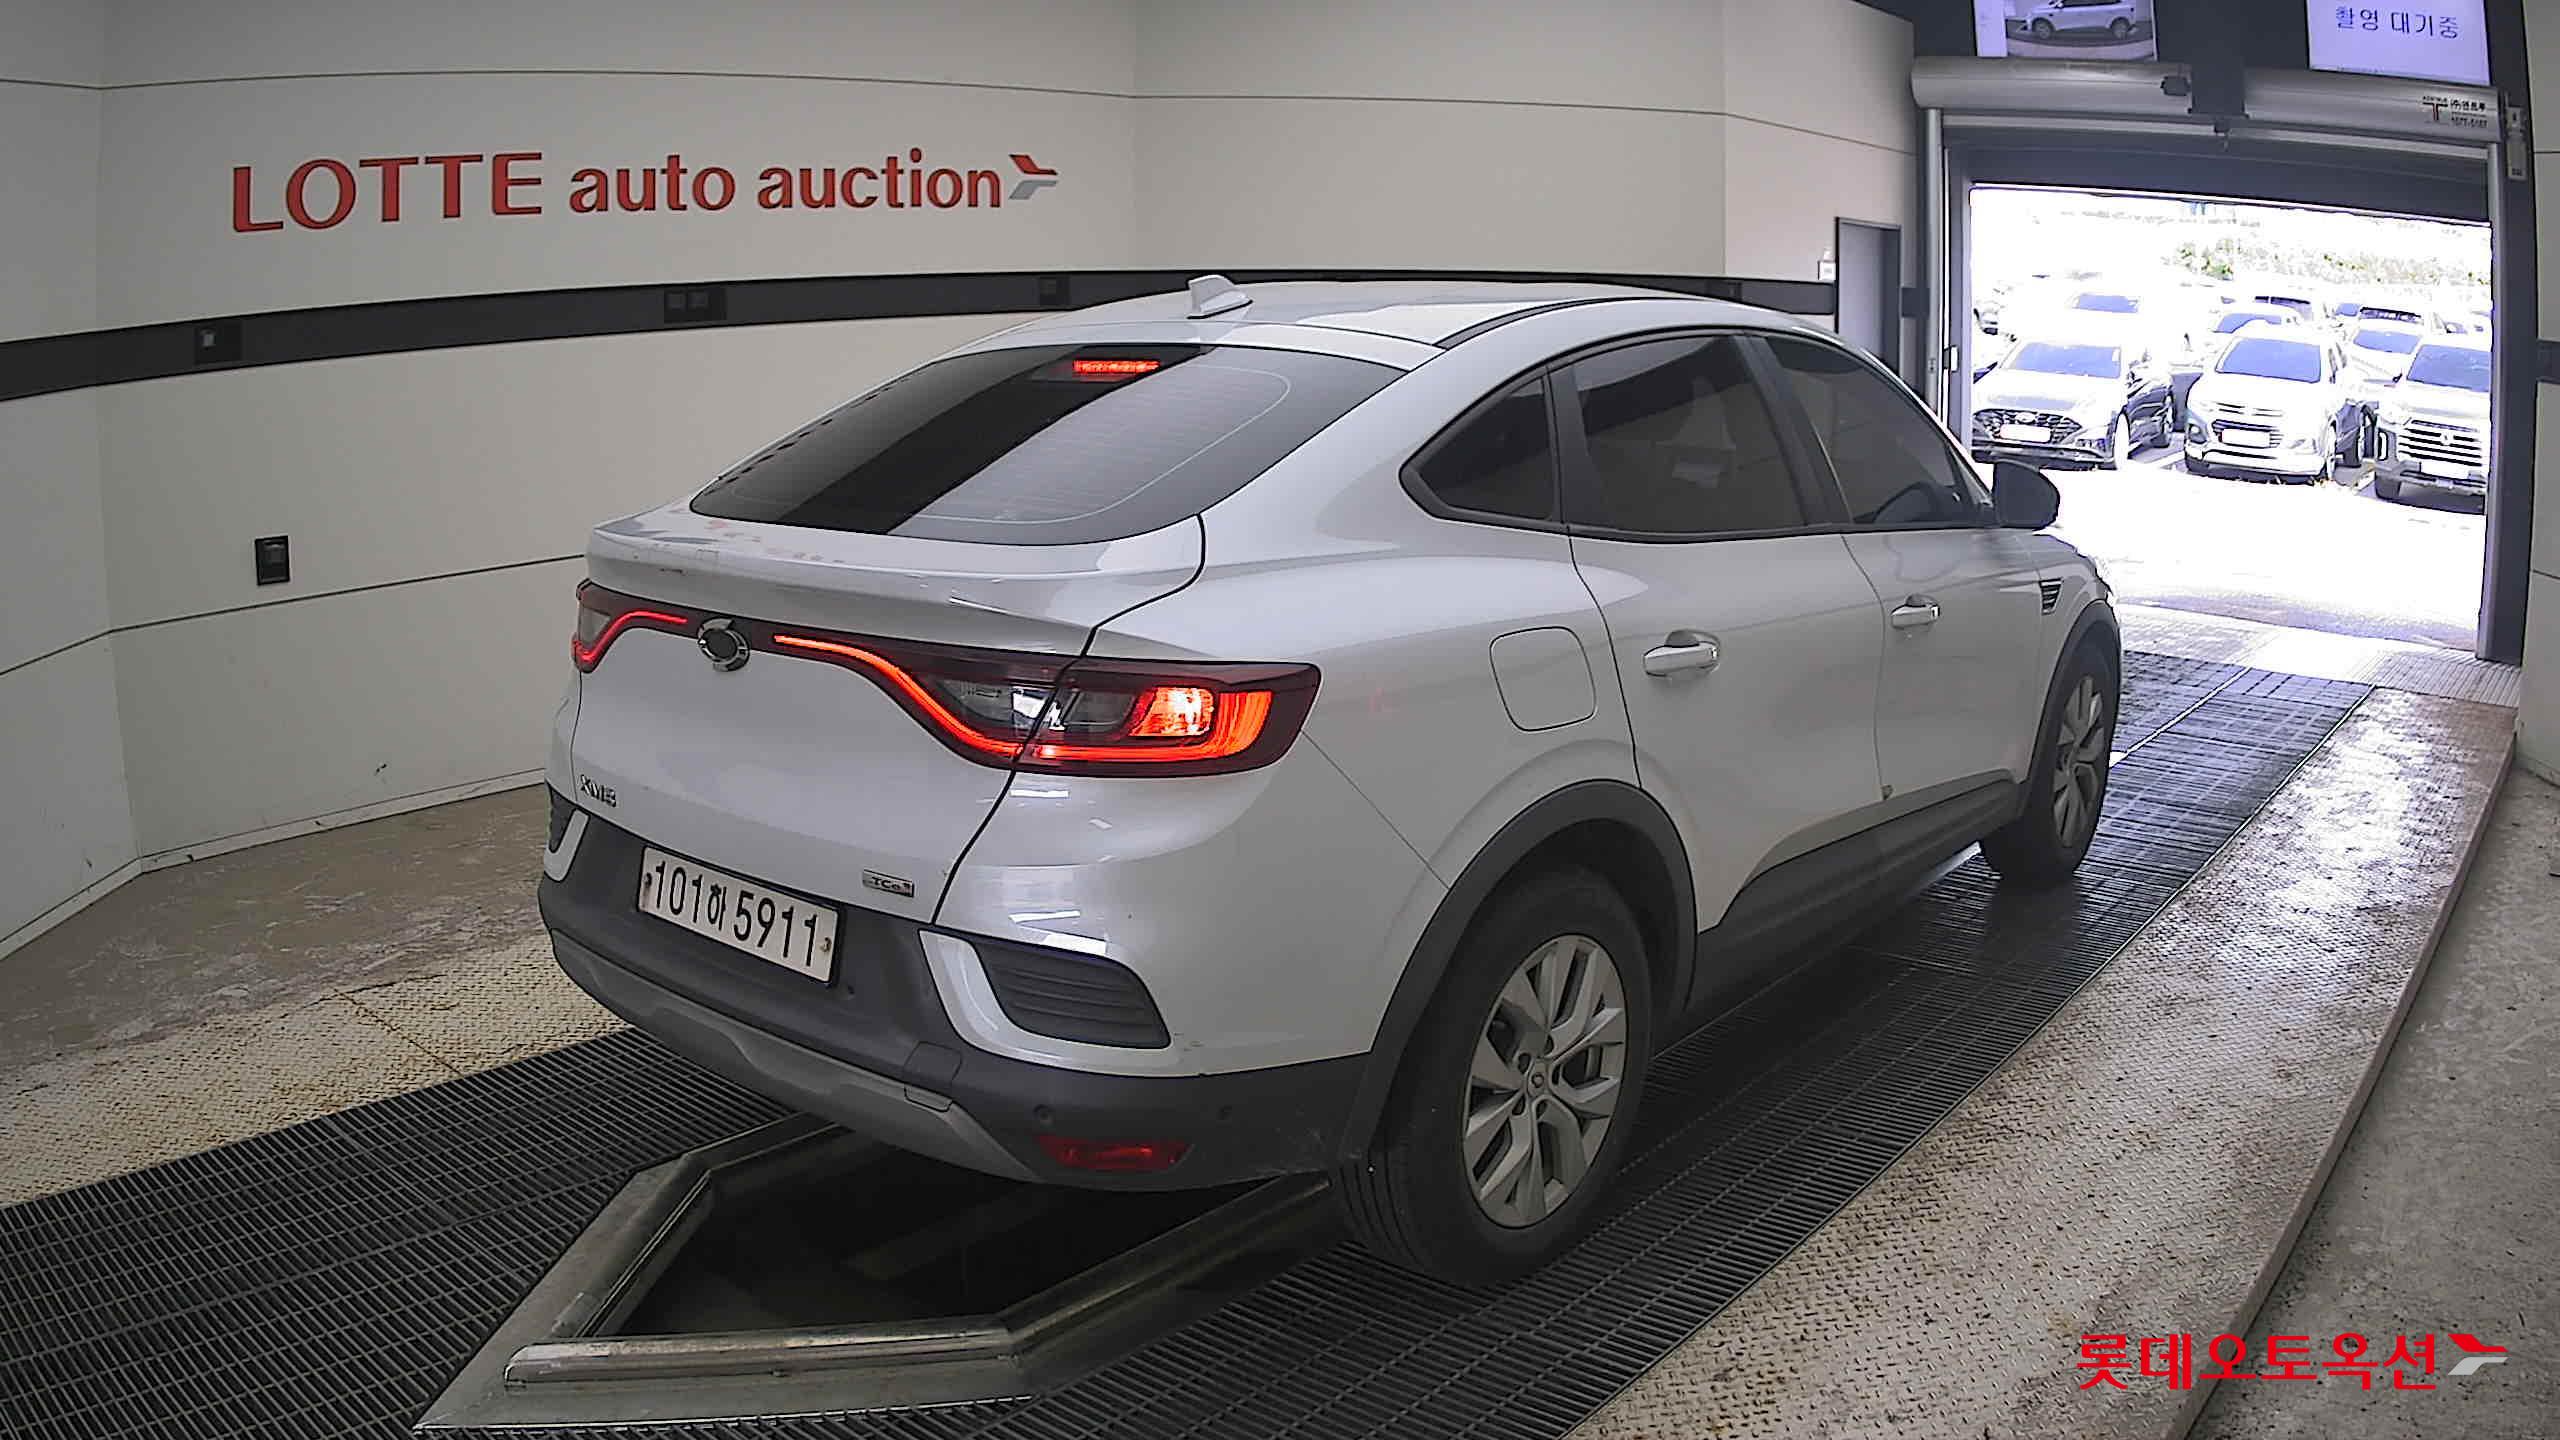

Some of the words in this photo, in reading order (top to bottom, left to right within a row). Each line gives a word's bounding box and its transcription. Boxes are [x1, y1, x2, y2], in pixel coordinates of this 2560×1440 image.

[2336, 6, 2379, 32] 촬영
[2391, 12, 2458, 40] 대기중
[233, 151, 541, 234] LOTTE
[568, 154, 738, 214] auto
[757, 148, 1003, 209] auction
[655, 859, 728, 932] 101하
[733, 892, 818, 968] 5911
